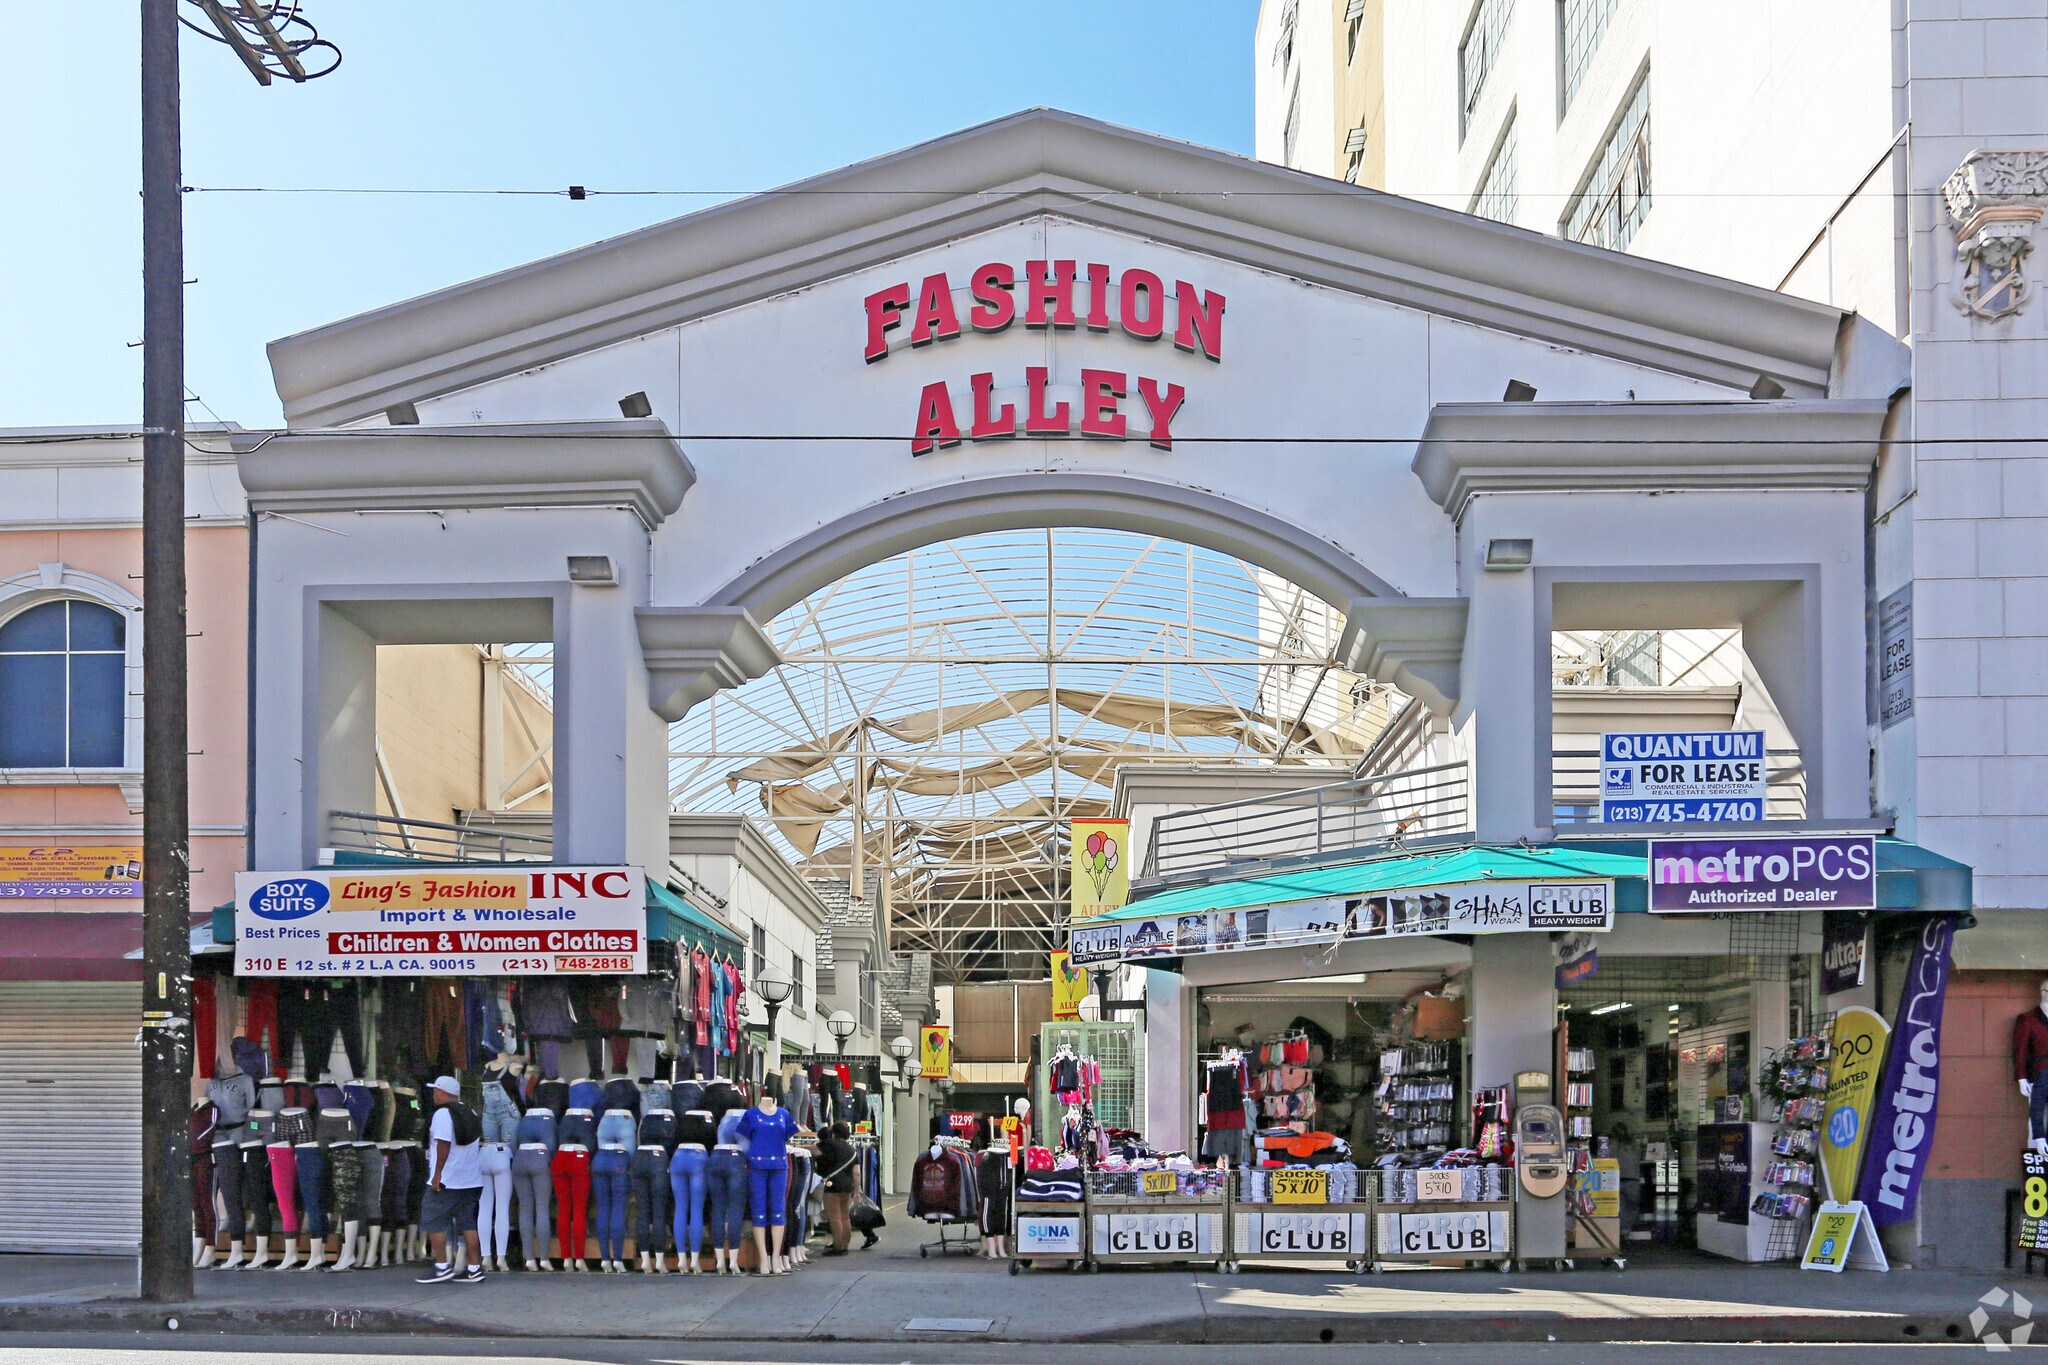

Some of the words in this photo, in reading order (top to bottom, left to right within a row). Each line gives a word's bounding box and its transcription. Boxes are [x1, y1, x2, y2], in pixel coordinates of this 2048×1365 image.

[864, 260, 1226, 364] FASHION
[911, 366, 1185, 457] ALLEY
[1886, 639, 1905, 658] FOR
[1881, 653, 1912, 682] LEASE
[1888, 688, 1905, 705] (213)
[1612, 734, 1756, 760] QUANTUM
[1641, 764, 1685, 783] FOR
[1694, 763, 1760, 782] LEASE
[1610, 806, 1644, 821] (213)
[1644, 802, 1756, 823] 745-4740
[1654, 844, 1871, 884] metroPCS
[33, 888, 133, 896] 749-0762
[266, 884, 307, 897] BOY
[341, 881, 411, 903] Ling's
[422, 880, 516, 902] Fashion
[529, 872, 631, 899] INC
[1541, 887, 1594, 903] PRO
[1688, 889, 1776, 904] Authorized
[1784, 888, 1838, 901] Dealer
[260, 898, 315, 912] SUITS
[1454, 895, 1523, 925] SHAKA
[1532, 899, 1603, 915] CLUB
[380, 909, 446, 925] Import
[452, 908, 467, 922] &
[473, 907, 576, 922] Wholesale
[1567, 917, 1602, 925] WEIGHT
[245, 927, 274, 939] Best
[279, 927, 320, 939] Prices
[1080, 929, 1113, 942] PRO
[1124, 930, 1174, 945] ALSTYLE
[338, 934, 429, 952] Children
[437, 932, 453, 952] &
[459, 932, 540, 951] Women
[547, 931, 633, 950] Clothes
[1074, 938, 1119, 954] CLUB
[245, 958, 272, 971] 310
[277, 958, 287, 971] E
[296, 960, 313, 971] 12
[318, 960, 337, 971] st.
[342, 960, 351, 971] #
[356, 960, 365, 971] 2
[369, 960, 393, 970] L.A
[394, 959, 425, 970] CA.
[430, 959, 476, 970] 90015
[502, 959, 548, 971] (213)
[559, 957, 629, 969] 748-2818
[1075, 954, 1095, 963] HEAVY
[1095, 952, 1118, 960] WEIGHT
[1060, 1001, 1079, 1010] ALLE
[925, 1066, 945, 1074] ALLEY
[1523, 1075, 1546, 1084] ATM
[1827, 1070, 1868, 1093] NLIMITED
[949, 1114, 973, 1127] $12.99
[1274, 1170, 1325, 1179] SOCKS
[2026, 1165, 2045, 1174] on
[2024, 1176, 2048, 1218] 8
[1122, 1216, 1185, 1236] PRO
[1275, 1214, 1338, 1236] PRO
[1414, 1213, 1477, 1236] PRO
[2021, 1226, 2037, 1234] Free
[2022, 1219, 2038, 1227] Free
[1027, 1225, 1070, 1238] SUNA
[2020, 1233, 2036, 1241] Free
[1112, 1231, 1194, 1251] CLUB
[1265, 1230, 1347, 1250] CLUB
[1404, 1229, 1487, 1251] CLUB
[2018, 1240, 2035, 1248] Free
